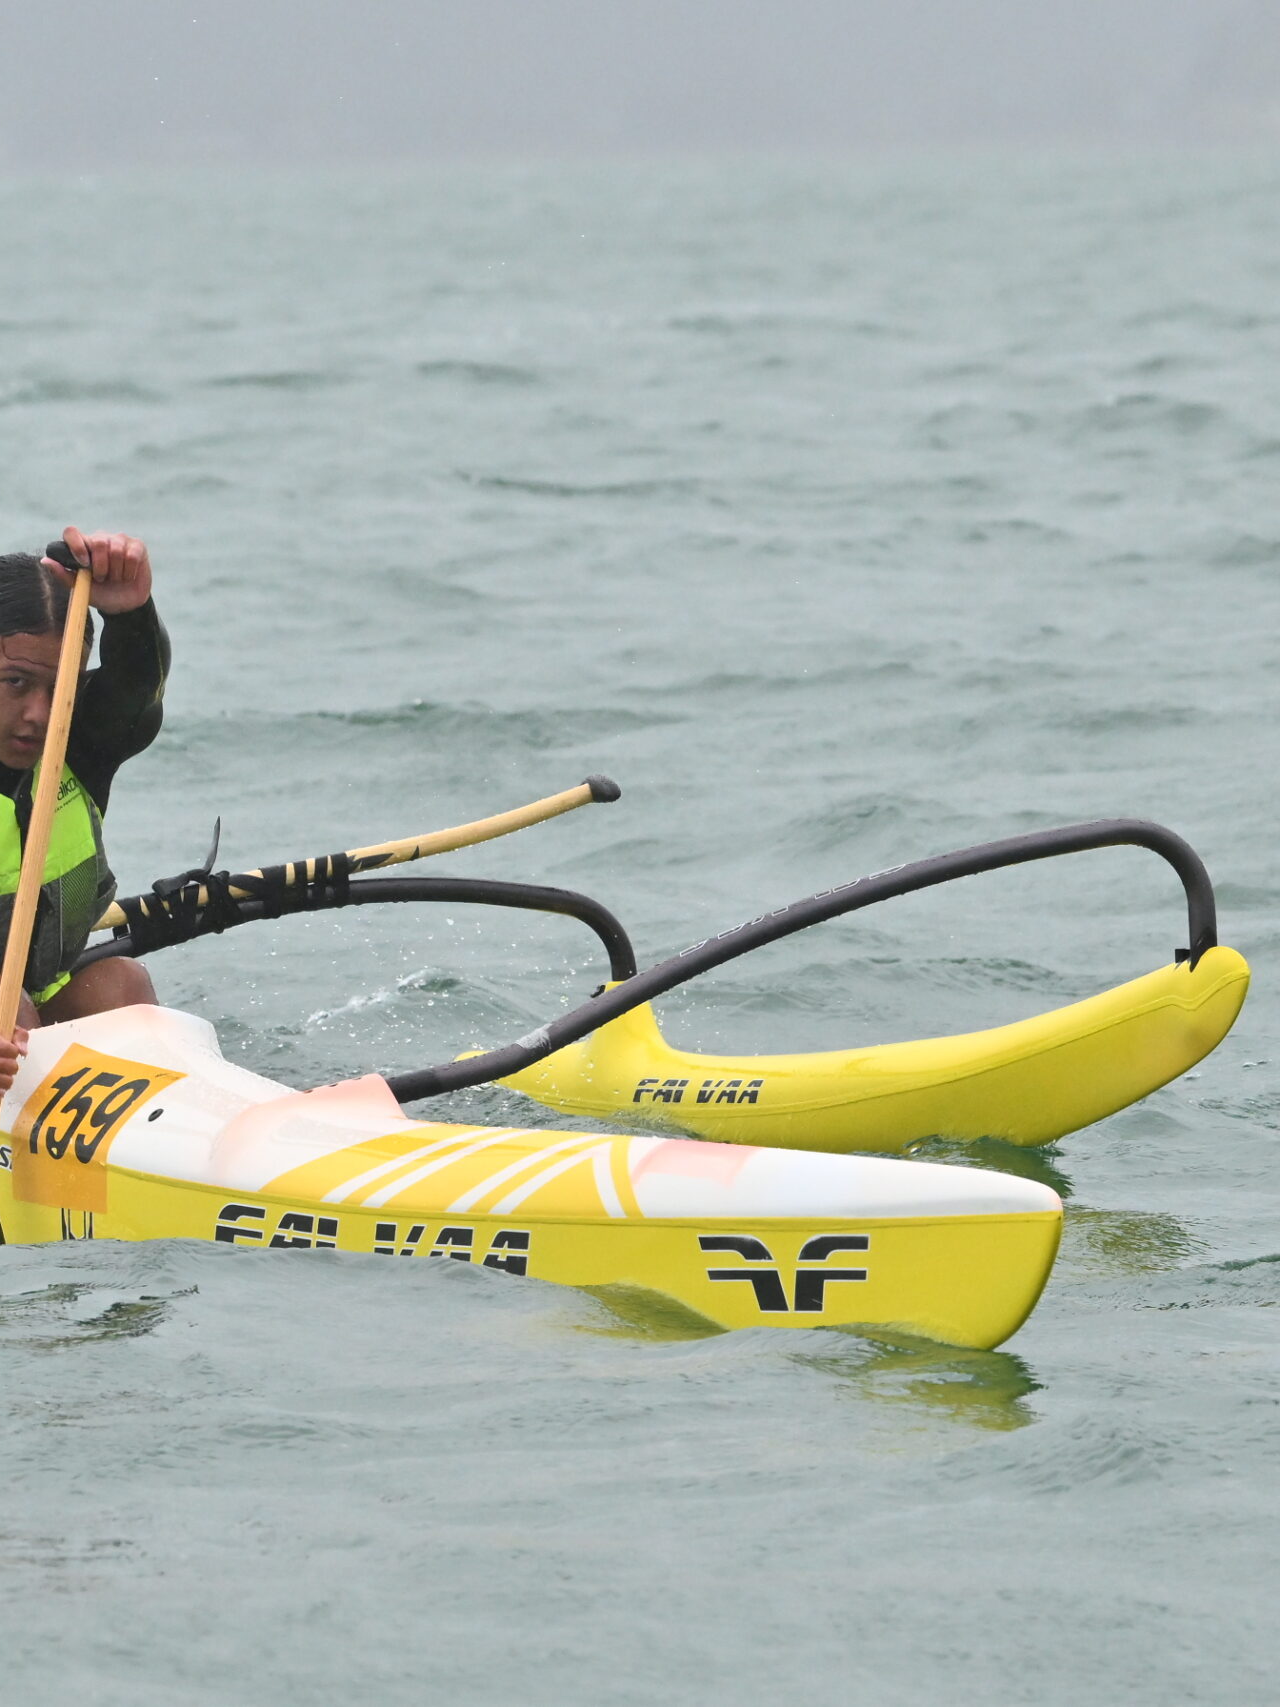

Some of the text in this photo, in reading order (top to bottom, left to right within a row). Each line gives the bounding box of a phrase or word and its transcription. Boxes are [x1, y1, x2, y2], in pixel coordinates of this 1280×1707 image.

[631, 1078, 765, 1104] FAI VAA
[28, 1066, 151, 1165] 159
[214, 1203, 339, 1251] FAI
